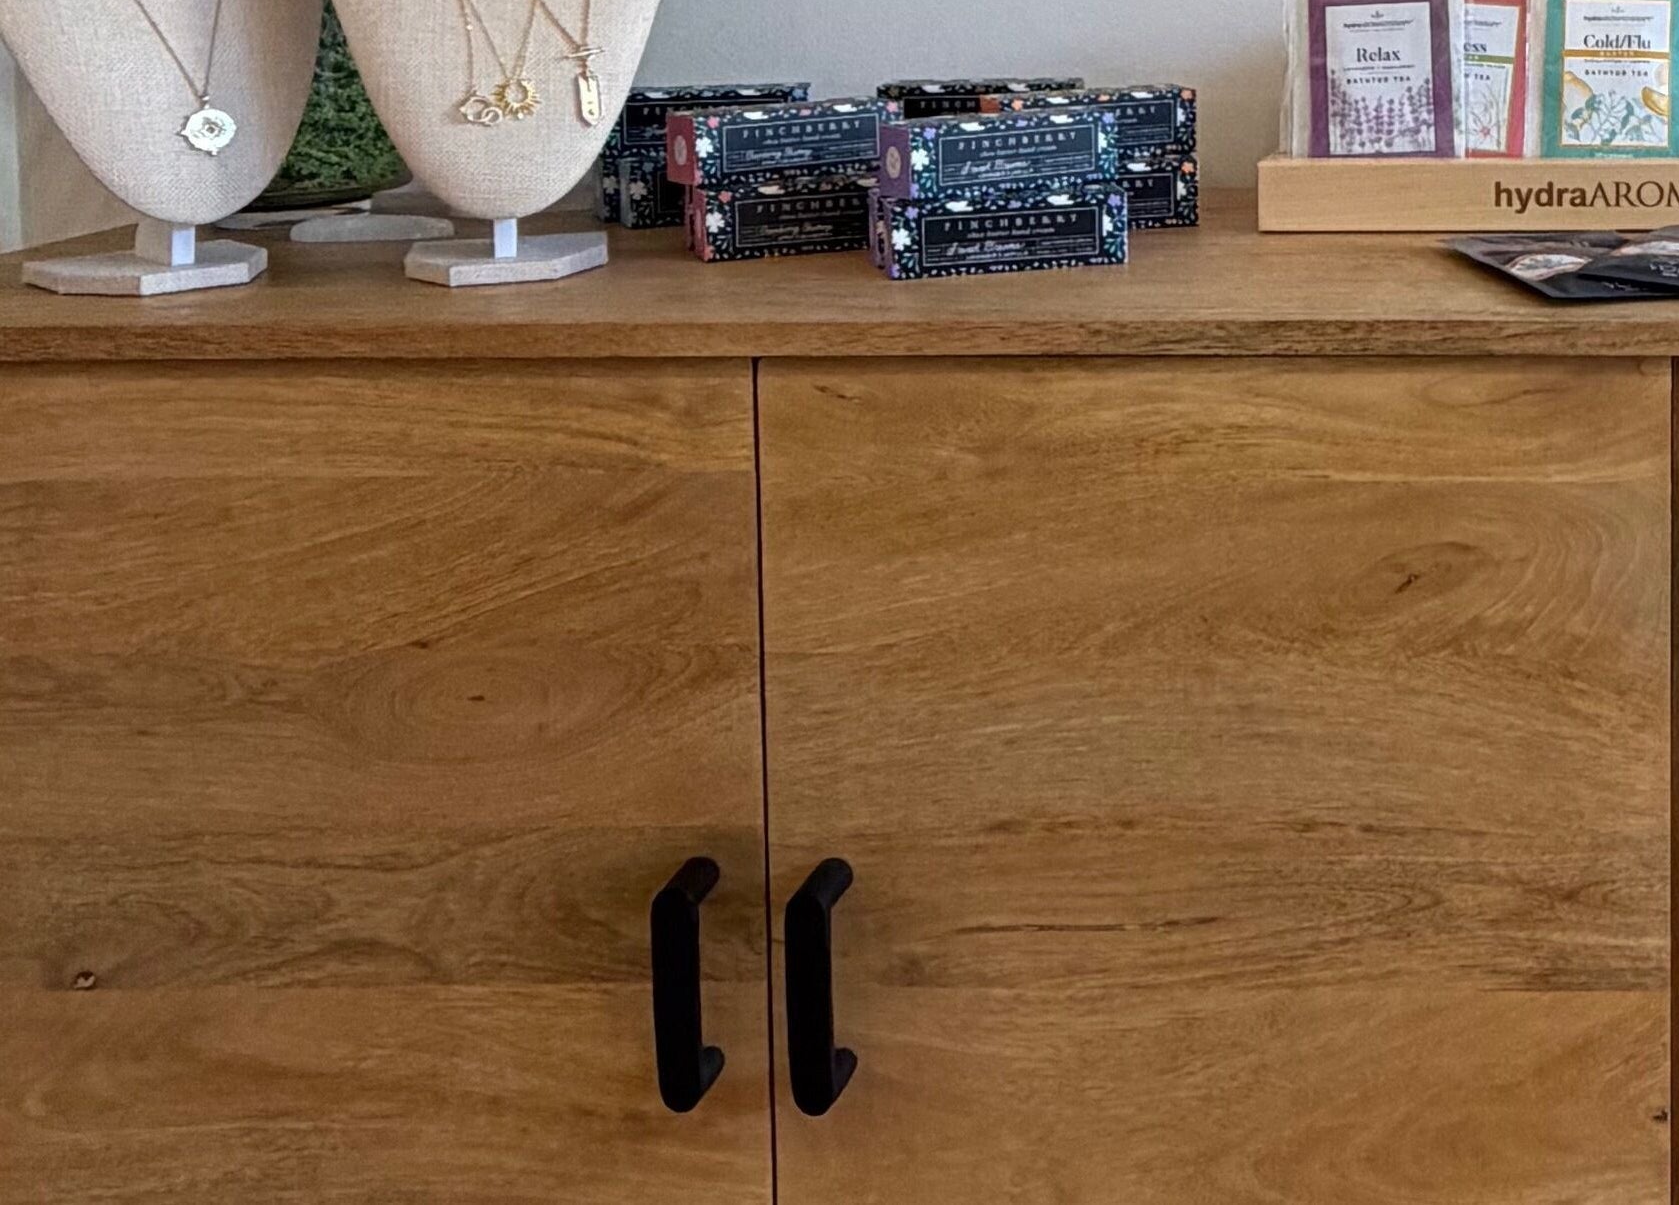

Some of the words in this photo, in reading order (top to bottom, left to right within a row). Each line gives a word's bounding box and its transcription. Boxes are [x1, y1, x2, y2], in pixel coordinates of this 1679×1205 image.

[1583, 34, 1651, 49] Cold/Flu
[1356, 47, 1401, 63] Relax
[743, 120, 860, 138] FINCHBERRY
[958, 132, 1076, 150] FINCHBERRY
[944, 213, 1078, 231] FINCHBERRY
